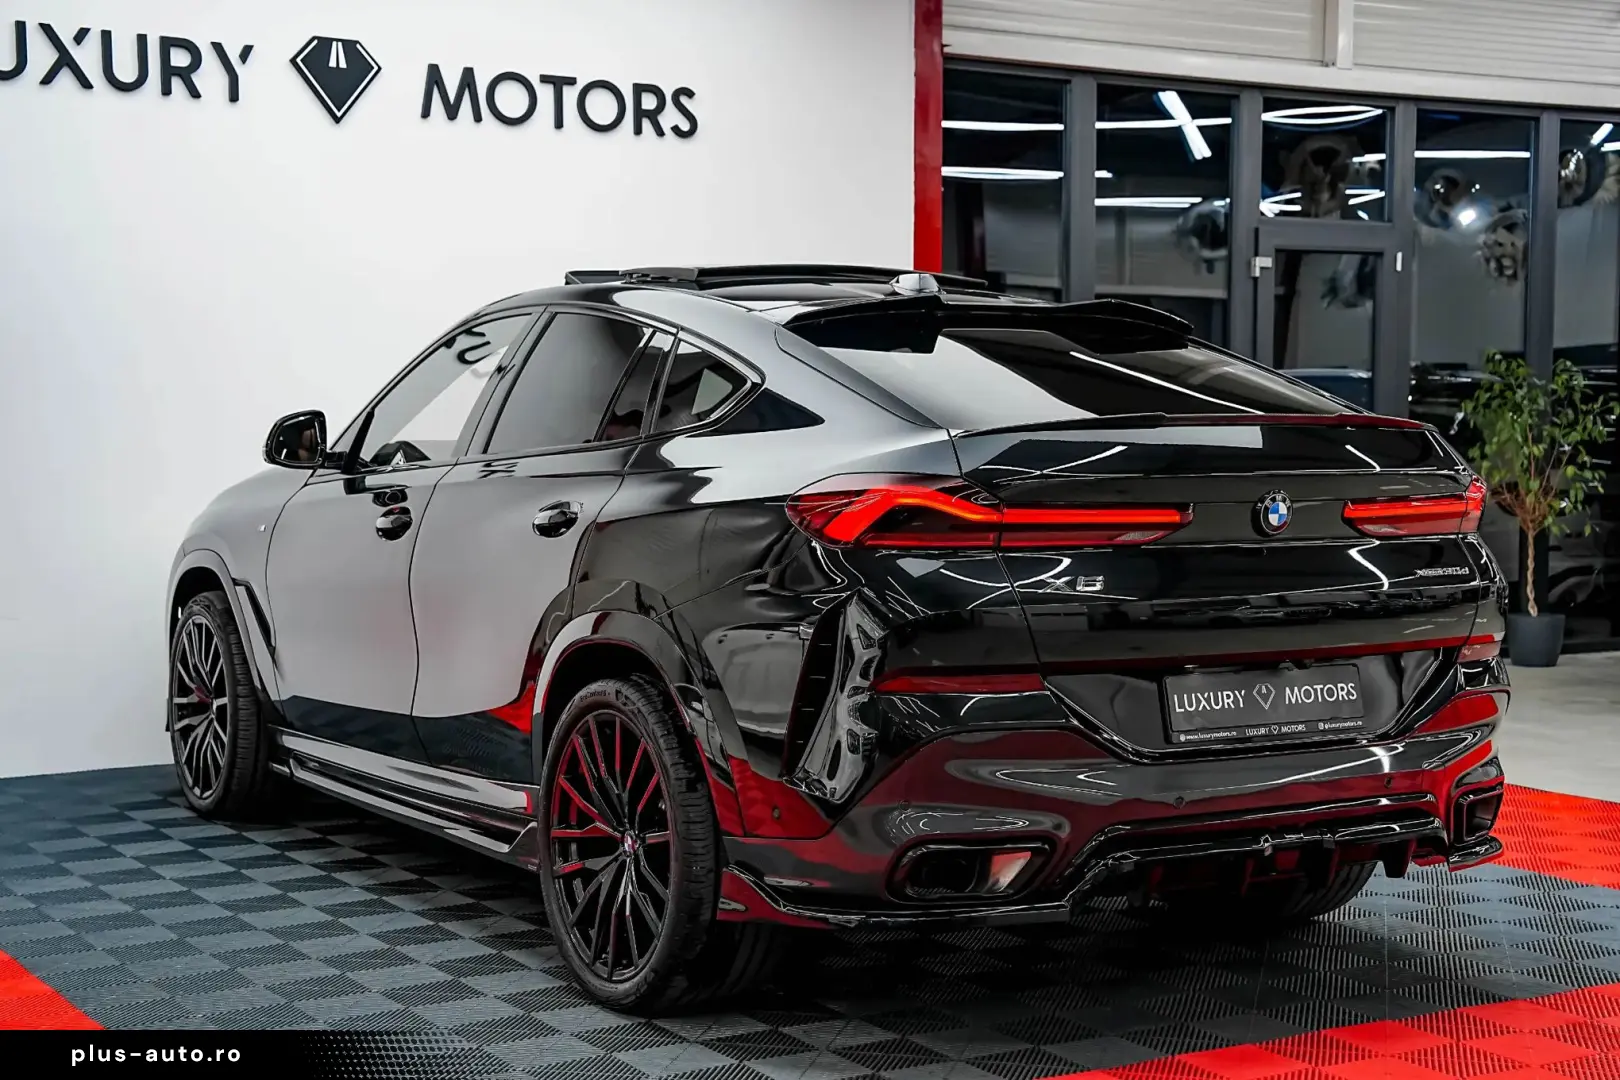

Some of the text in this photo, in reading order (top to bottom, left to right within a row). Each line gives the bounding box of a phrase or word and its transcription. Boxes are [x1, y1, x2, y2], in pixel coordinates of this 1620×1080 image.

[420, 63, 699, 139] MOTORS
[1041, 576, 1105, 592] X6
[1174, 682, 1358, 713] LUXURY MOTORS
[1245, 724, 1306, 736] LUXURY MOTORS
